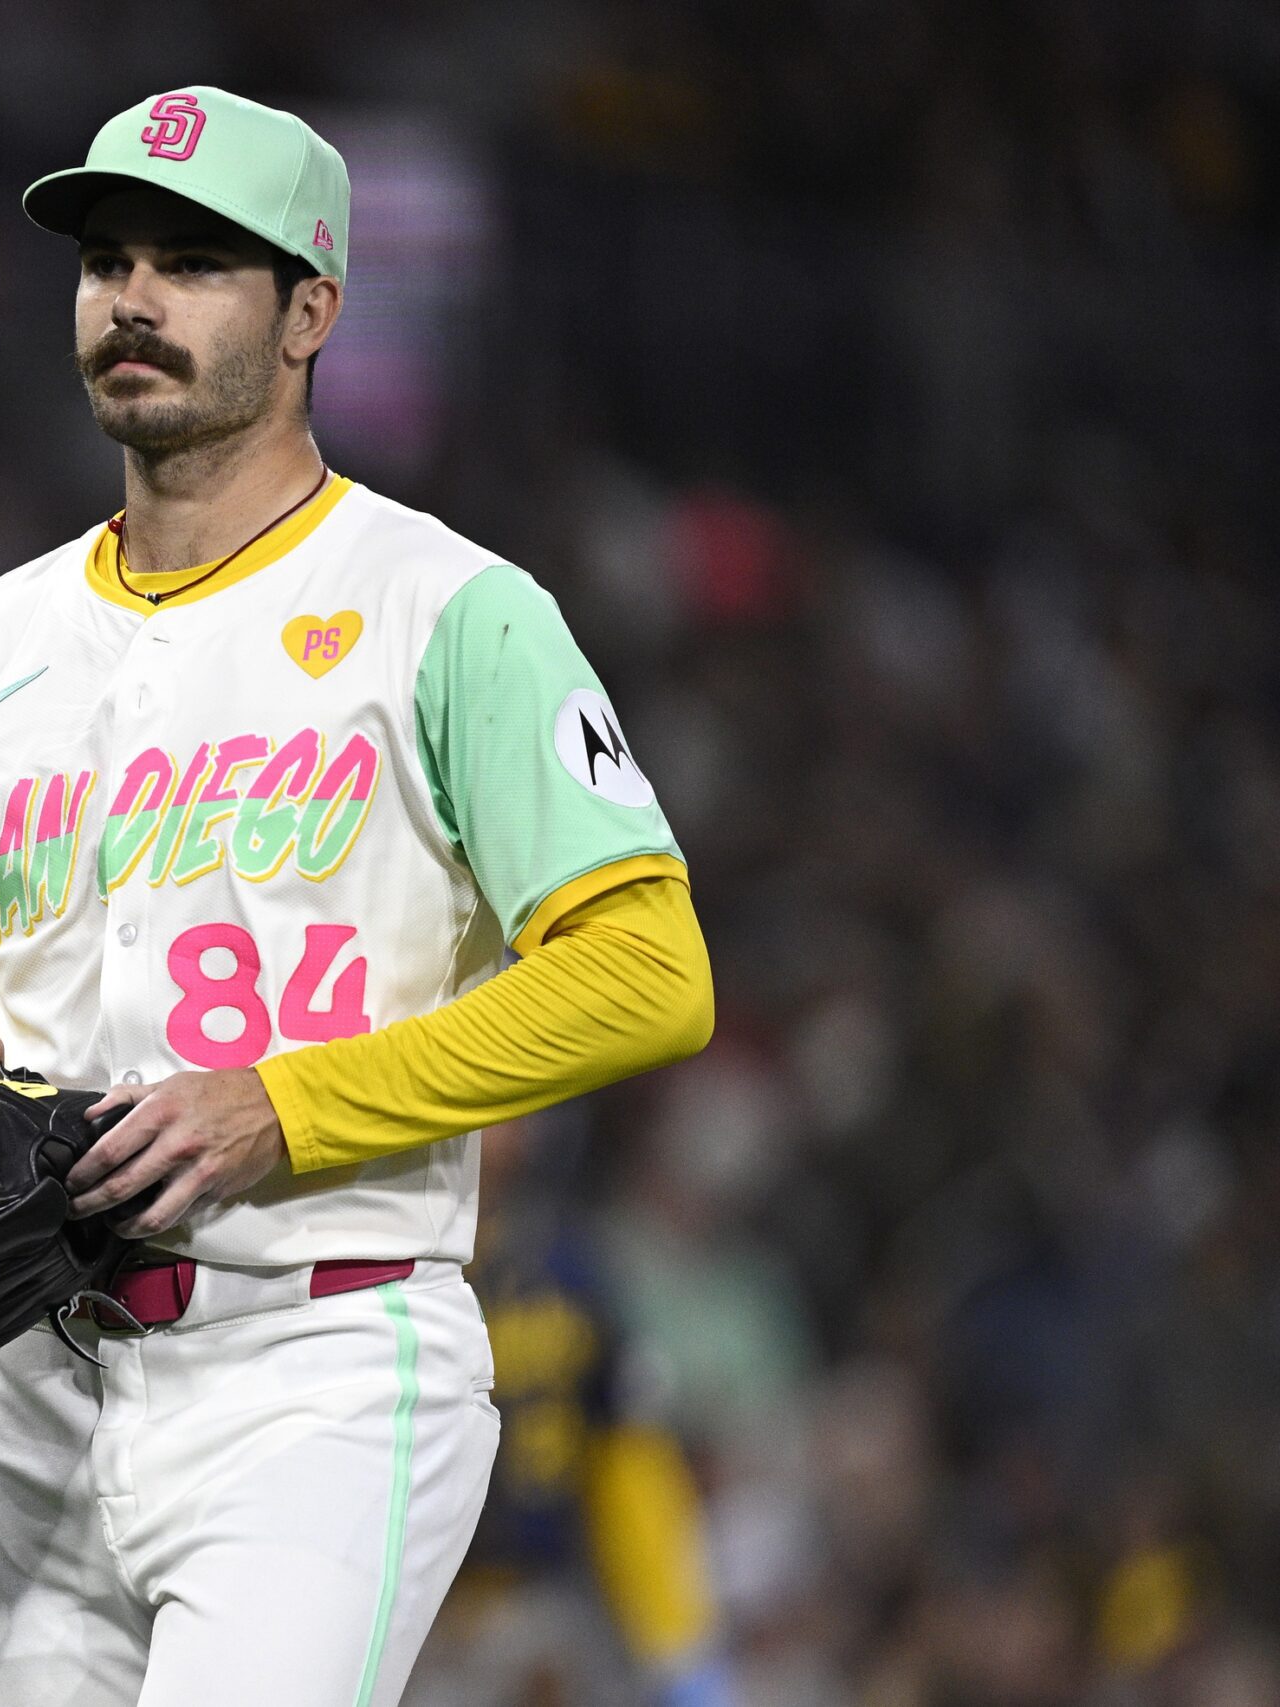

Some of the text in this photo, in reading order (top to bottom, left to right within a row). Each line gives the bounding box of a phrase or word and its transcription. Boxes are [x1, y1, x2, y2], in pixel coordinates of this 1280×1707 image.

[141, 93, 207, 161] SD
[303, 627, 340, 661] PS
[97, 727, 382, 905] DIEGO
[166, 923, 371, 1070] 84
